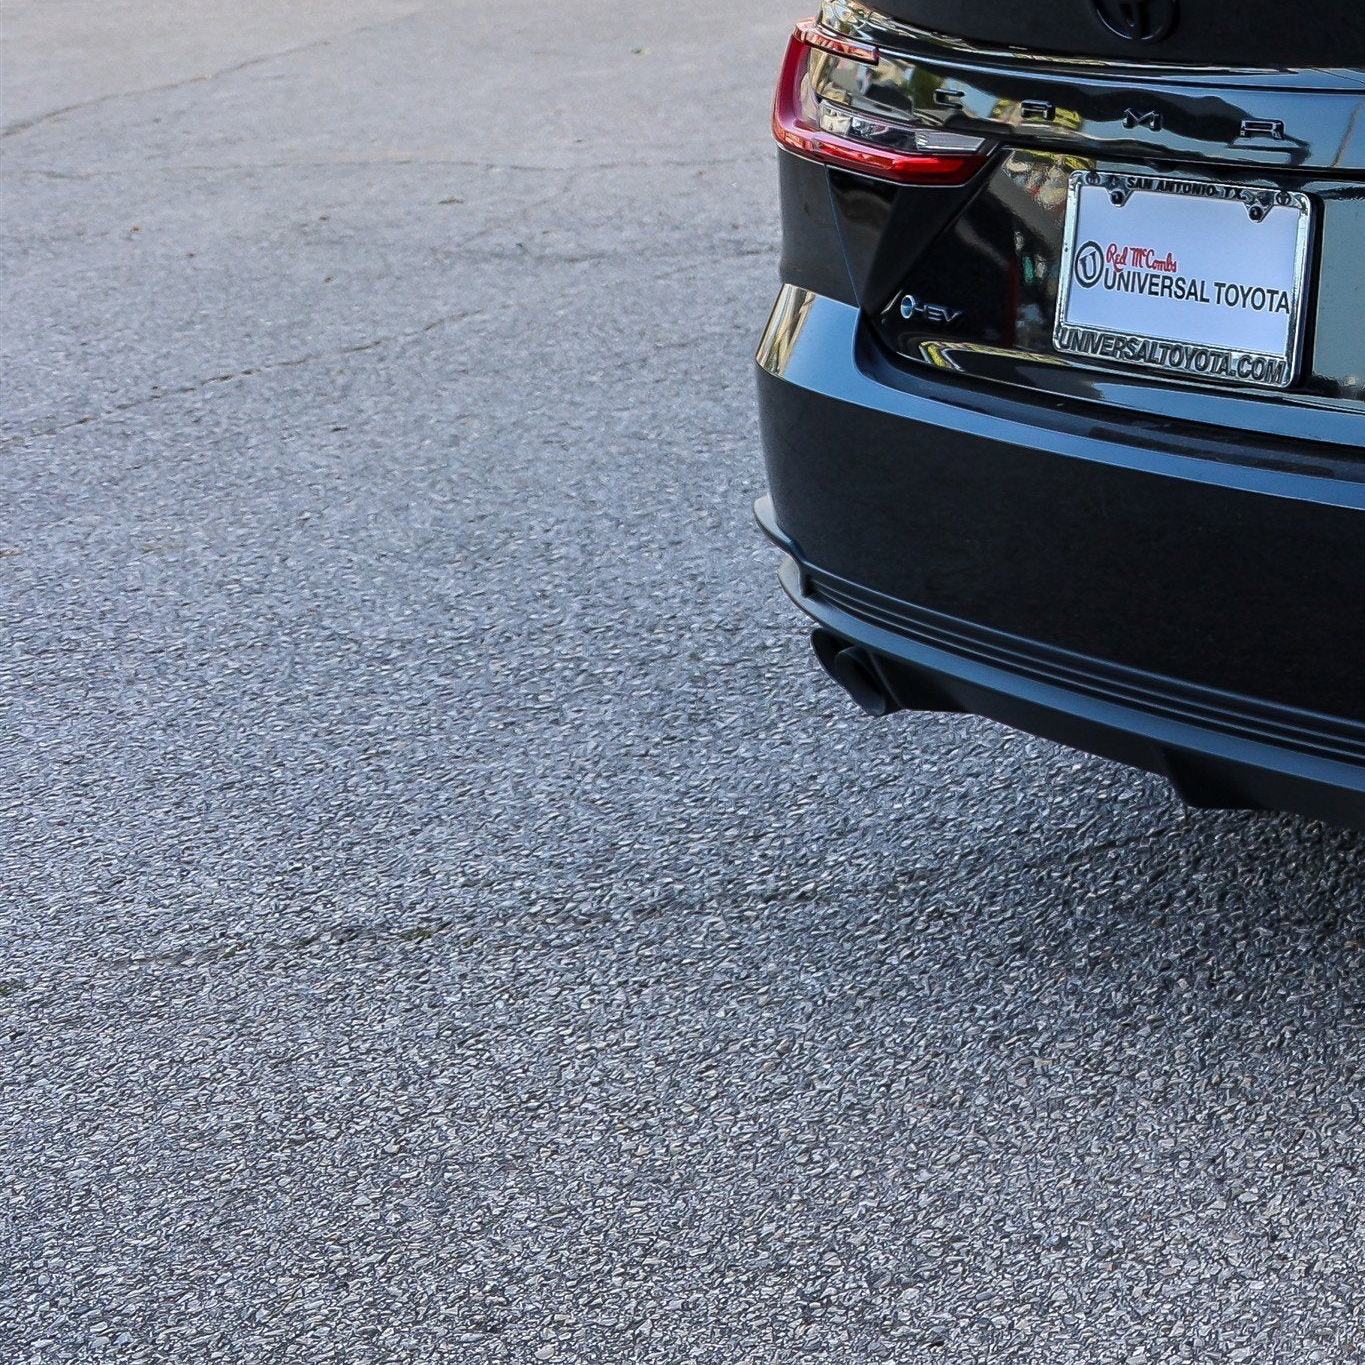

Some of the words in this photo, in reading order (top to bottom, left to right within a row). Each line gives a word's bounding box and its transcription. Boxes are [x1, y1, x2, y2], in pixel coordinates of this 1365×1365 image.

[1127, 176, 1153, 190] SAN
[1106, 243, 1129, 272] Red
[1104, 267, 1210, 303] UNIVERSAL
[1214, 281, 1290, 314] TOYOTA
[1057, 326, 1288, 385] UNIVERSALTOYOTA.COM
